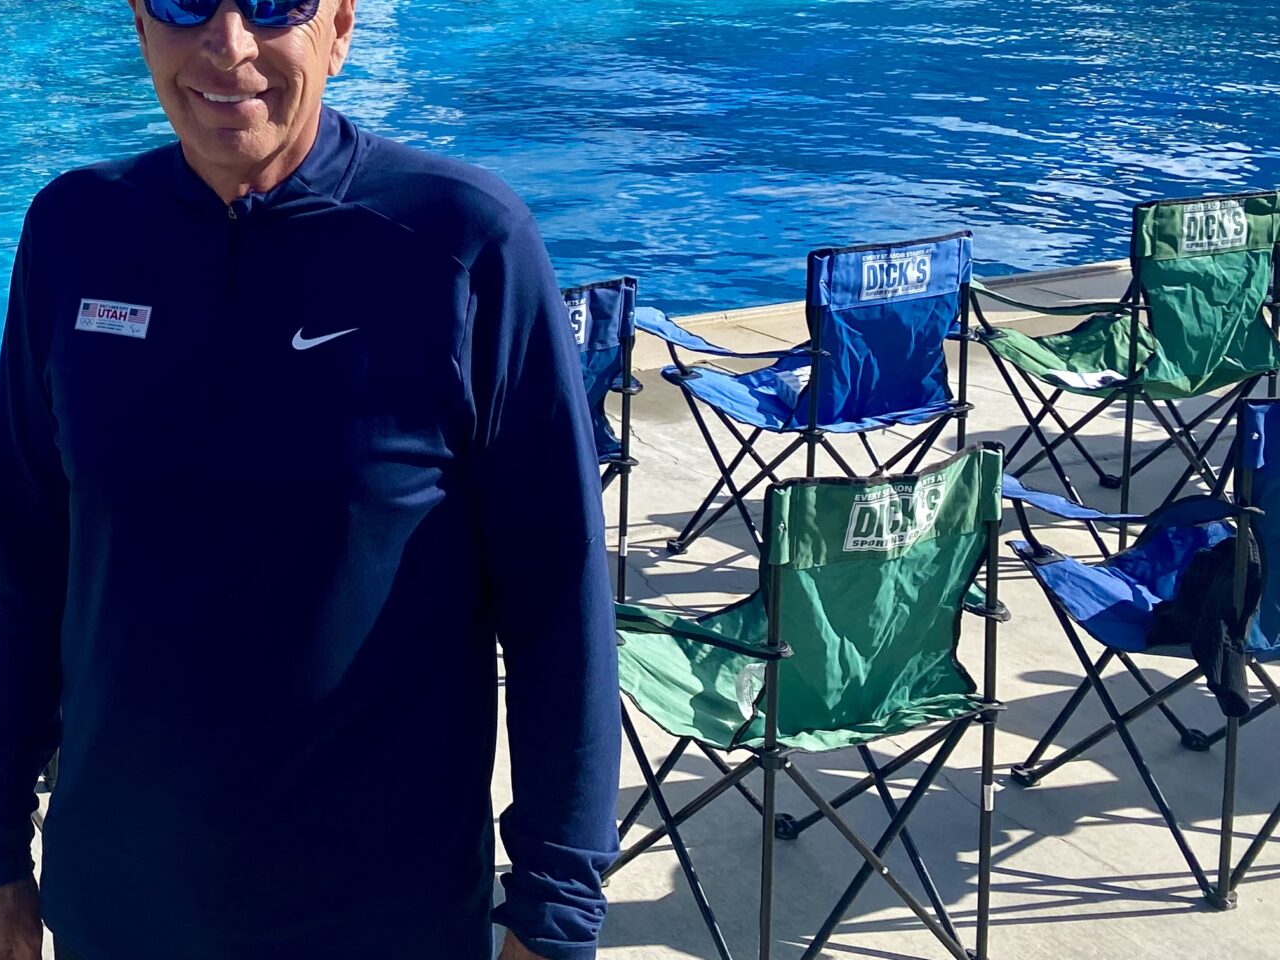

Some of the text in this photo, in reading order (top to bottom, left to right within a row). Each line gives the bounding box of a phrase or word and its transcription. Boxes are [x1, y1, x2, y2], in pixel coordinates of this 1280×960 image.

[1186, 209, 1244, 242] DICK'S
[866, 258, 927, 291] DICK'S
[98, 308, 128, 322] UTAH
[855, 490, 881, 502] EVERY
